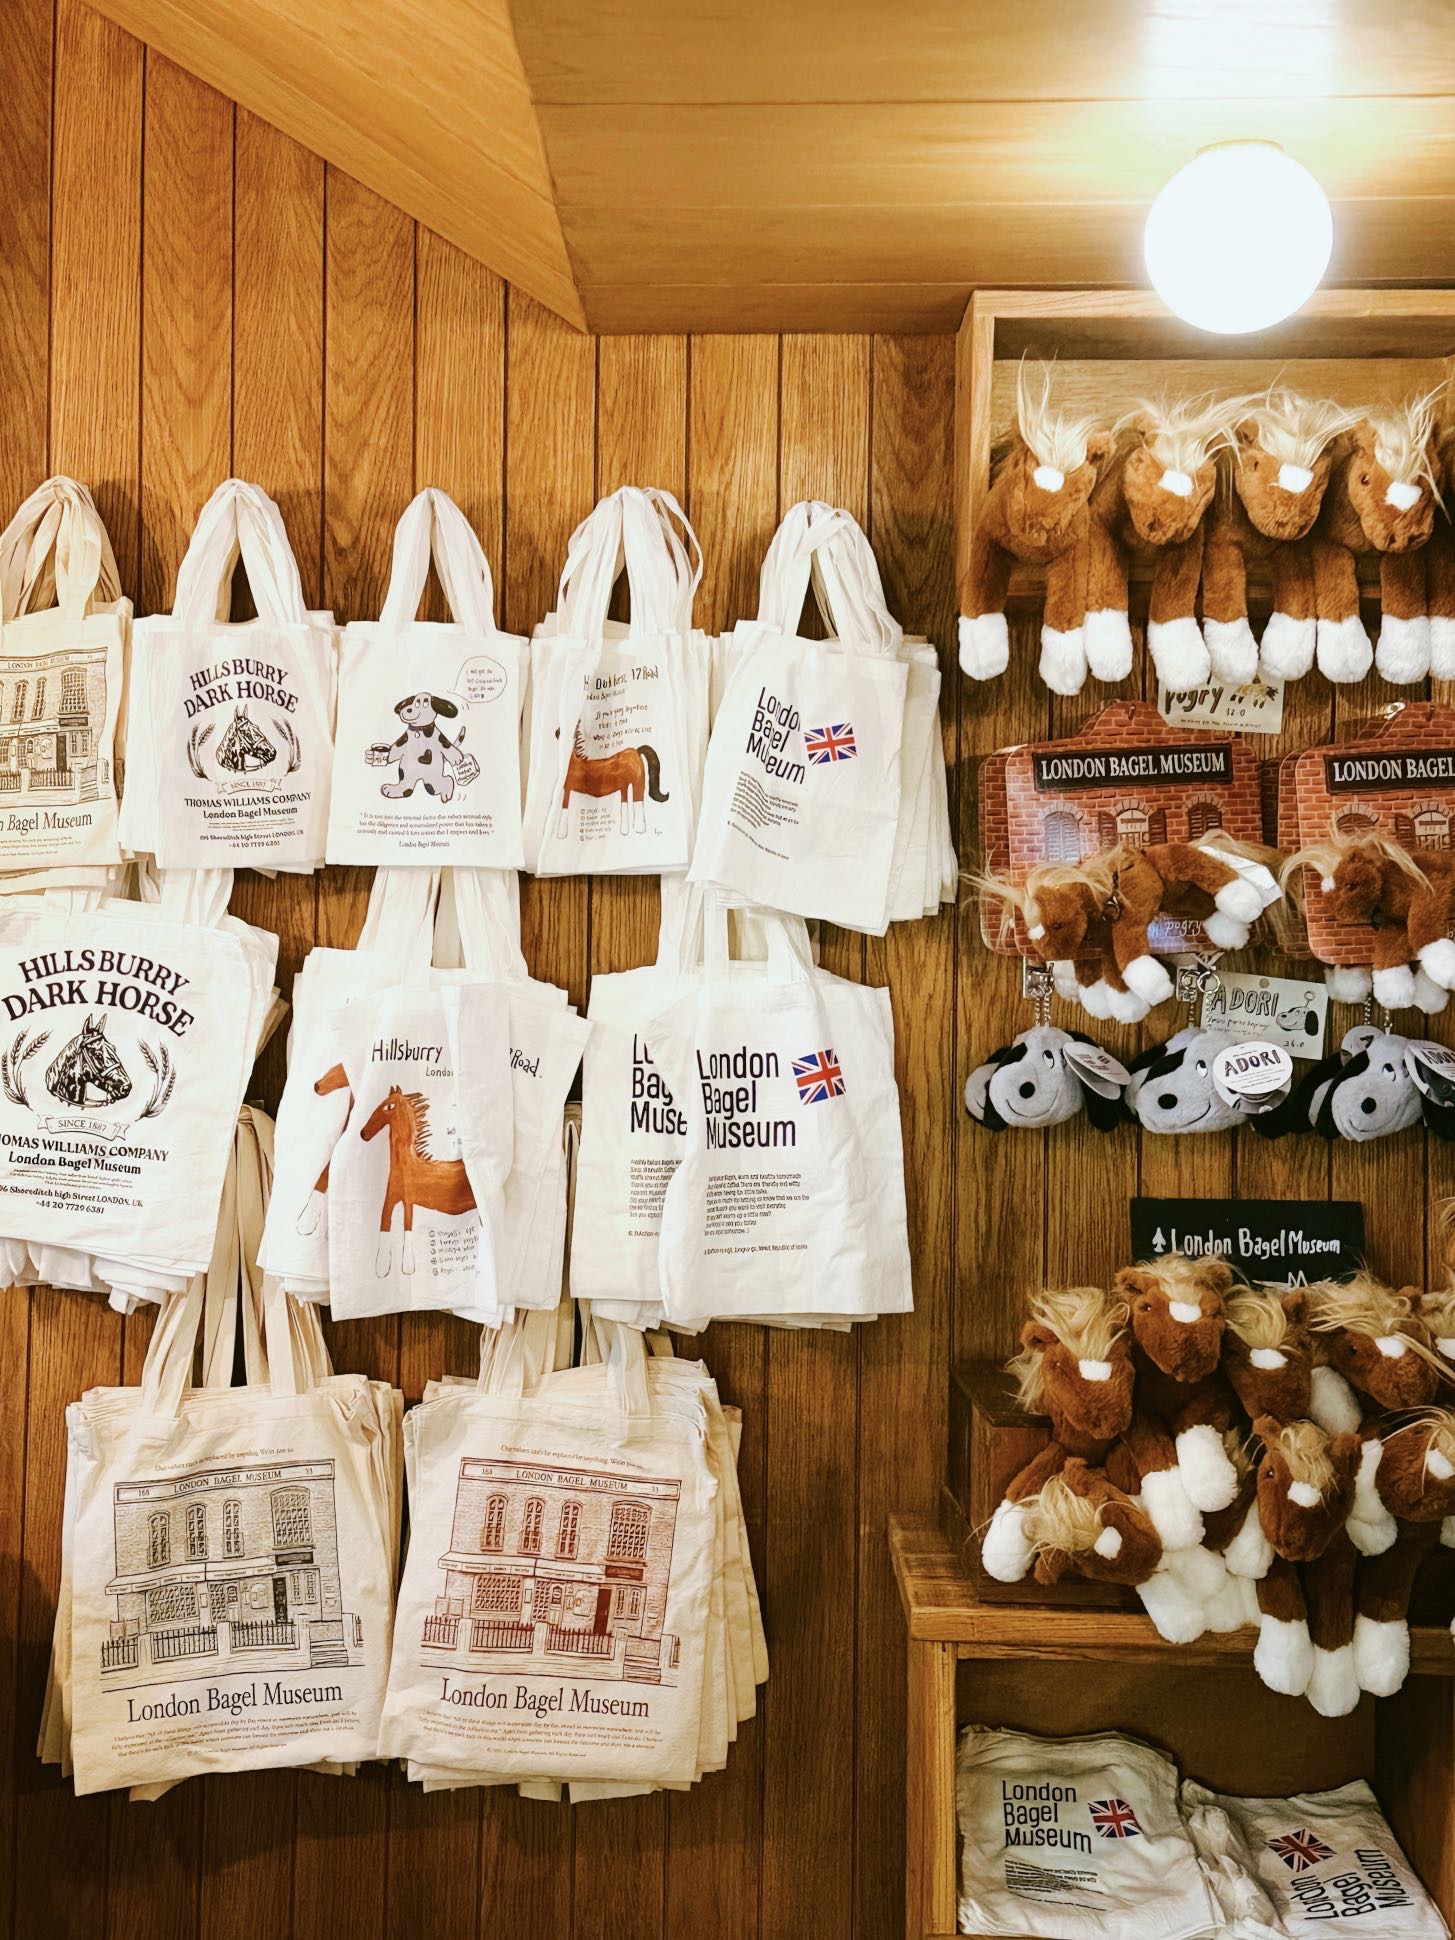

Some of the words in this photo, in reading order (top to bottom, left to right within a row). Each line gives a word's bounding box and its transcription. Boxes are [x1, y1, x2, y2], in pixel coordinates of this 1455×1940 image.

[183, 682, 233, 718] DARK
[236, 681, 299, 713] HORSE
[745, 732, 806, 785] Mueum
[1041, 756, 1106, 780] LONDON
[1109, 754, 1158, 777] BAGEL
[1160, 752, 1226, 774] MUSEUM
[1333, 759, 1402, 782] LONDON
[1405, 756, 1455, 779] BAGEL
[184, 798, 222, 807] THOMAS
[223, 796, 271, 807] WILLIAMS
[203, 810, 236, 819] London
[238, 808, 261, 819] Bagel
[263, 807, 298, 816] Museum
[7, 812, 39, 836] Bagel
[42, 812, 93, 829] Museum
[0, 980, 89, 1021] DARK
[95, 980, 195, 1037] HORSE
[1211, 984, 1280, 1017] ADORI
[371, 1038, 443, 1063] Hillsburry
[696, 1046, 779, 1080] London
[1224, 1049, 1281, 1077] ADORI
[701, 1080, 757, 1120] Bagel
[58, 1119, 86, 1128] SINCE
[706, 1117, 796, 1150] Museum
[8, 1151, 56, 1167] London
[58, 1156, 92, 1171] Bagel
[93, 1158, 141, 1174] Museum
[42, 1138, 106, 1157] WILLIAMS
[109, 1146, 169, 1162] COMPANY
[1171, 1228, 1233, 1257] London
[1238, 1227, 1286, 1260] Bagel
[1288, 1230, 1341, 1255] Museum
[174, 1477, 209, 1493] LONDON
[214, 1475, 243, 1485] BAGEL
[246, 1471, 282, 1481] MUSEUM
[516, 1470, 553, 1482] LONDON
[557, 1475, 586, 1486] BAGEL
[590, 1478, 628, 1490] MUSEUM
[127, 1693, 201, 1723] London
[206, 1684, 257, 1716] Bagel
[263, 1681, 344, 1706] Museum
[440, 1677, 508, 1709] London
[514, 1685, 564, 1718] Bagel
[568, 1688, 650, 1718] Museum
[1002, 1780, 1077, 1803] London
[1003, 1802, 1059, 1828] Bagel
[1005, 1828, 1092, 1854] Museum
[1354, 1849, 1415, 1909] Museum
[1290, 1875, 1340, 1920] London
[1322, 1872, 1378, 1918] Bagel
